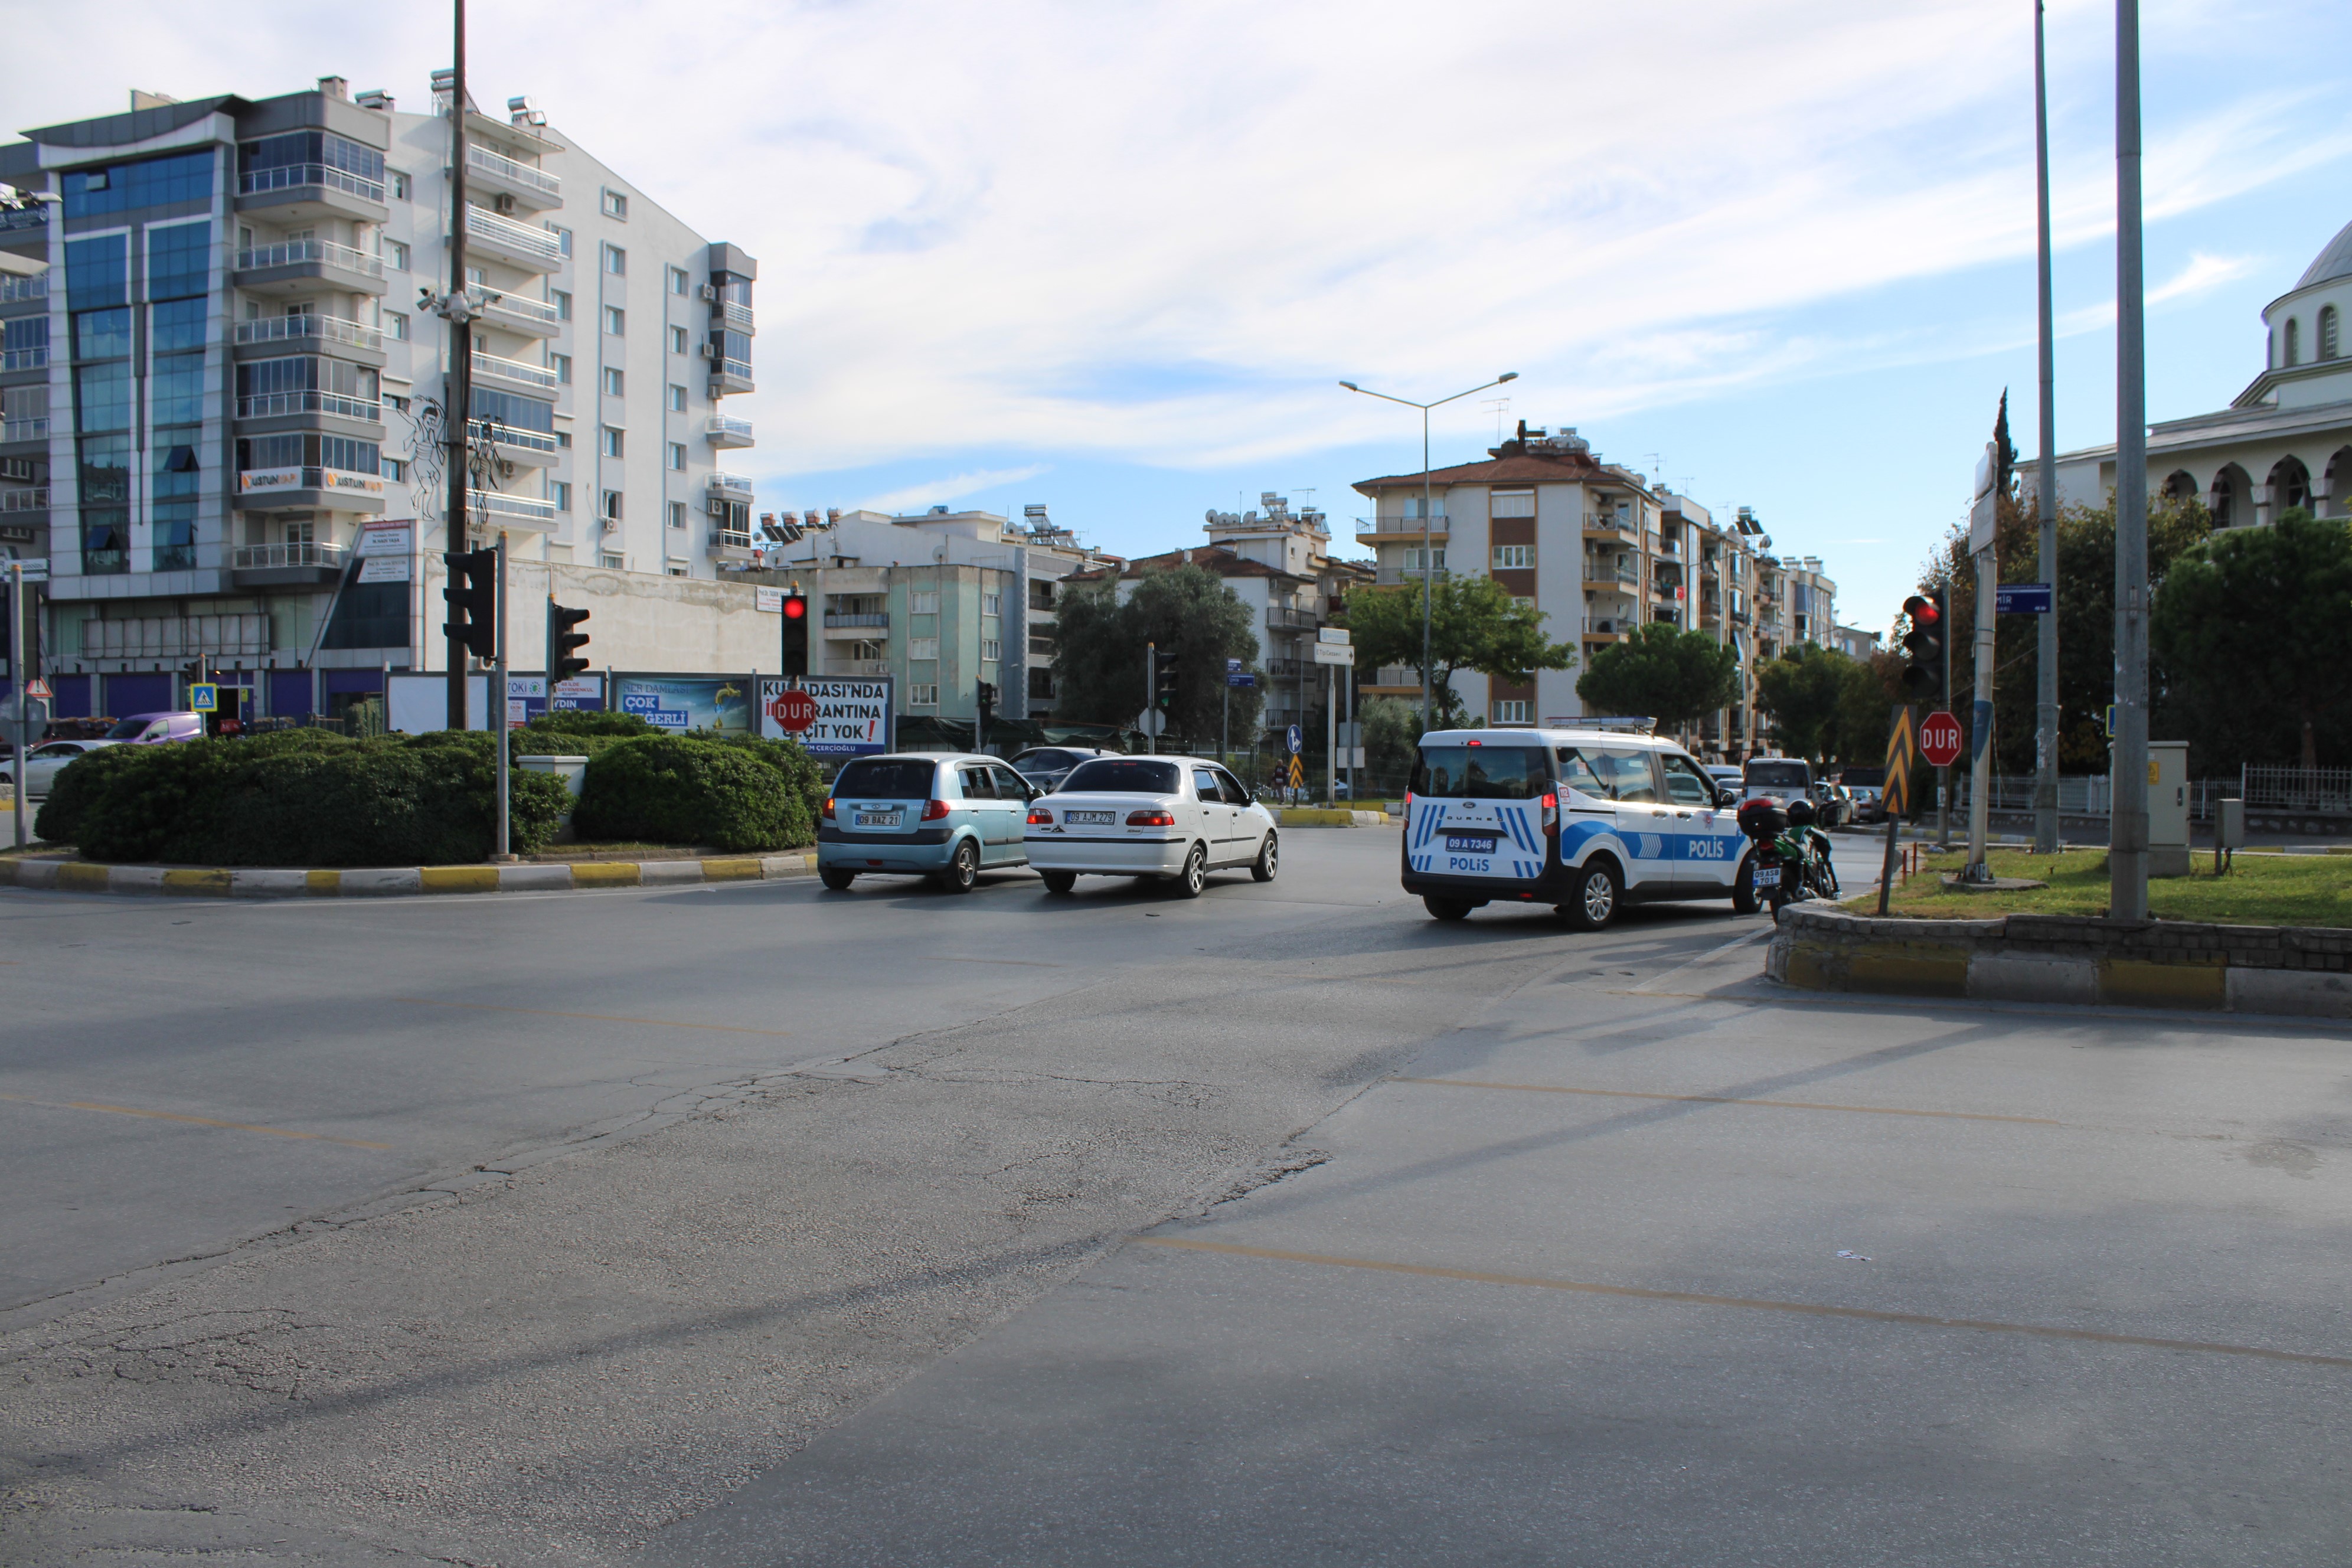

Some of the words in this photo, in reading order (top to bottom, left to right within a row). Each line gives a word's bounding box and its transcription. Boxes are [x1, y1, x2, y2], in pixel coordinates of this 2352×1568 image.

[1997, 594, 2012, 604] MİR
[623, 684, 643, 692] HER
[646, 684, 690, 694] DAMLASI
[554, 699, 577, 708] YDIN
[625, 697, 656, 711] ÇOK
[778, 703, 812, 719] DUR
[631, 710, 685, 725] ĞERLİ
[783, 721, 828, 743] ÇİT
[1923, 729, 1958, 749] DUR
[816, 744, 856, 752] ÇERÇİOĞLU
[859, 815, 869, 824] 09
[872, 816, 886, 825] BAZ
[889, 816, 899, 825] 21
[1071, 812, 1079, 821] 09
[1083, 812, 1097, 822] AJM
[1099, 812, 1113, 822] 279
[1449, 838, 1460, 848] 09
[1461, 839, 1468, 848] A
[1471, 839, 1492, 850] 7346
[1688, 836, 1724, 858] POLİS
[1765, 869, 1780, 877] ASB
